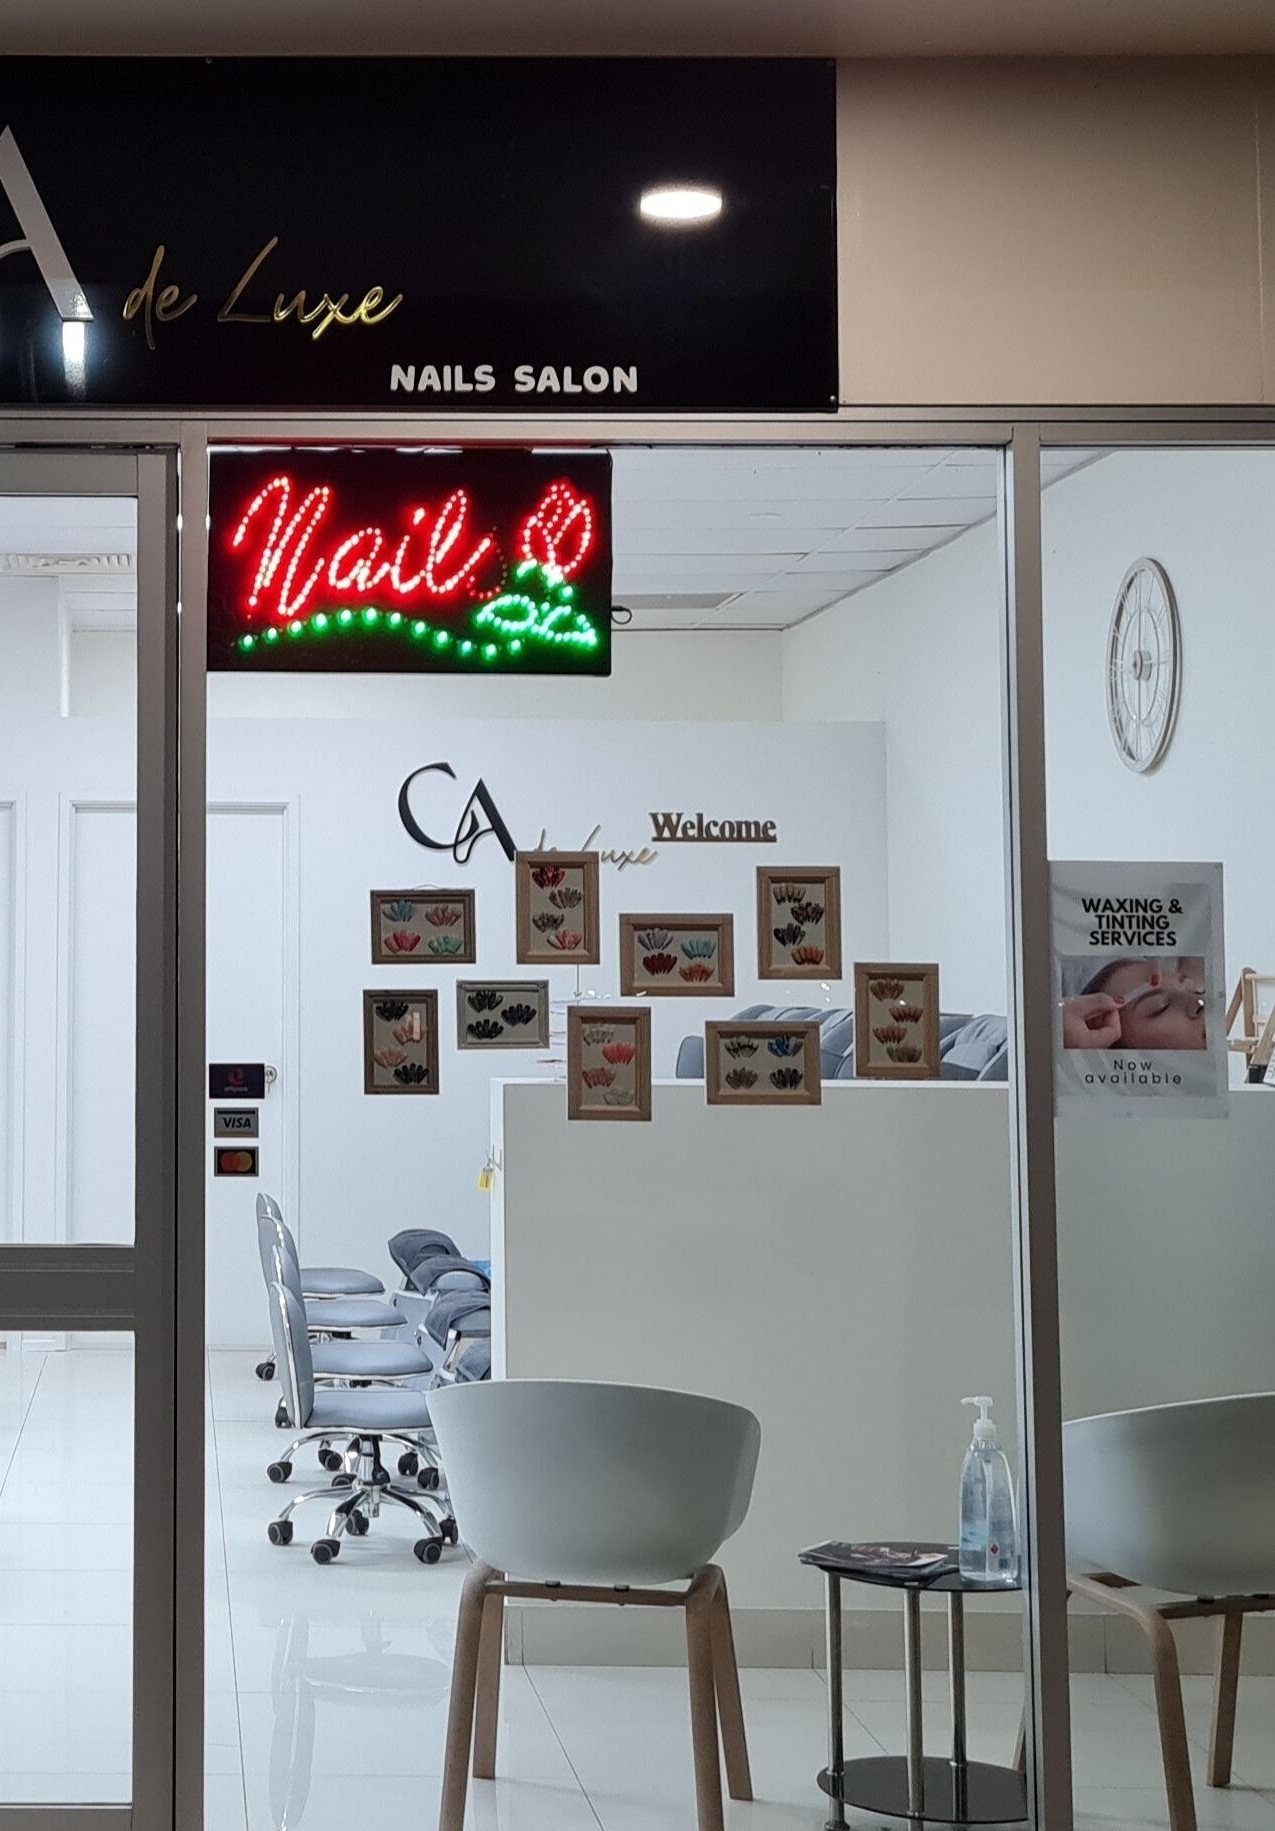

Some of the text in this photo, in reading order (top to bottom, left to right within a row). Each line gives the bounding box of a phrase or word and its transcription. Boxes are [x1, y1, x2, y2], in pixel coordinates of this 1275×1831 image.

[122, 245, 198, 350] de
[216, 236, 403, 341] Luxe
[389, 364, 639, 394] NAILS SALON
[232, 476, 492, 614] Nail
[650, 812, 777, 842] Welcome
[1082, 898, 1184, 914] WAXING &
[1094, 915, 1170, 930] TINTING
[1089, 931, 1177, 946] SERVICES
[1113, 1059, 1153, 1071] Now
[1084, 1072, 1182, 1085] available
[223, 1117, 252, 1128] VISA
